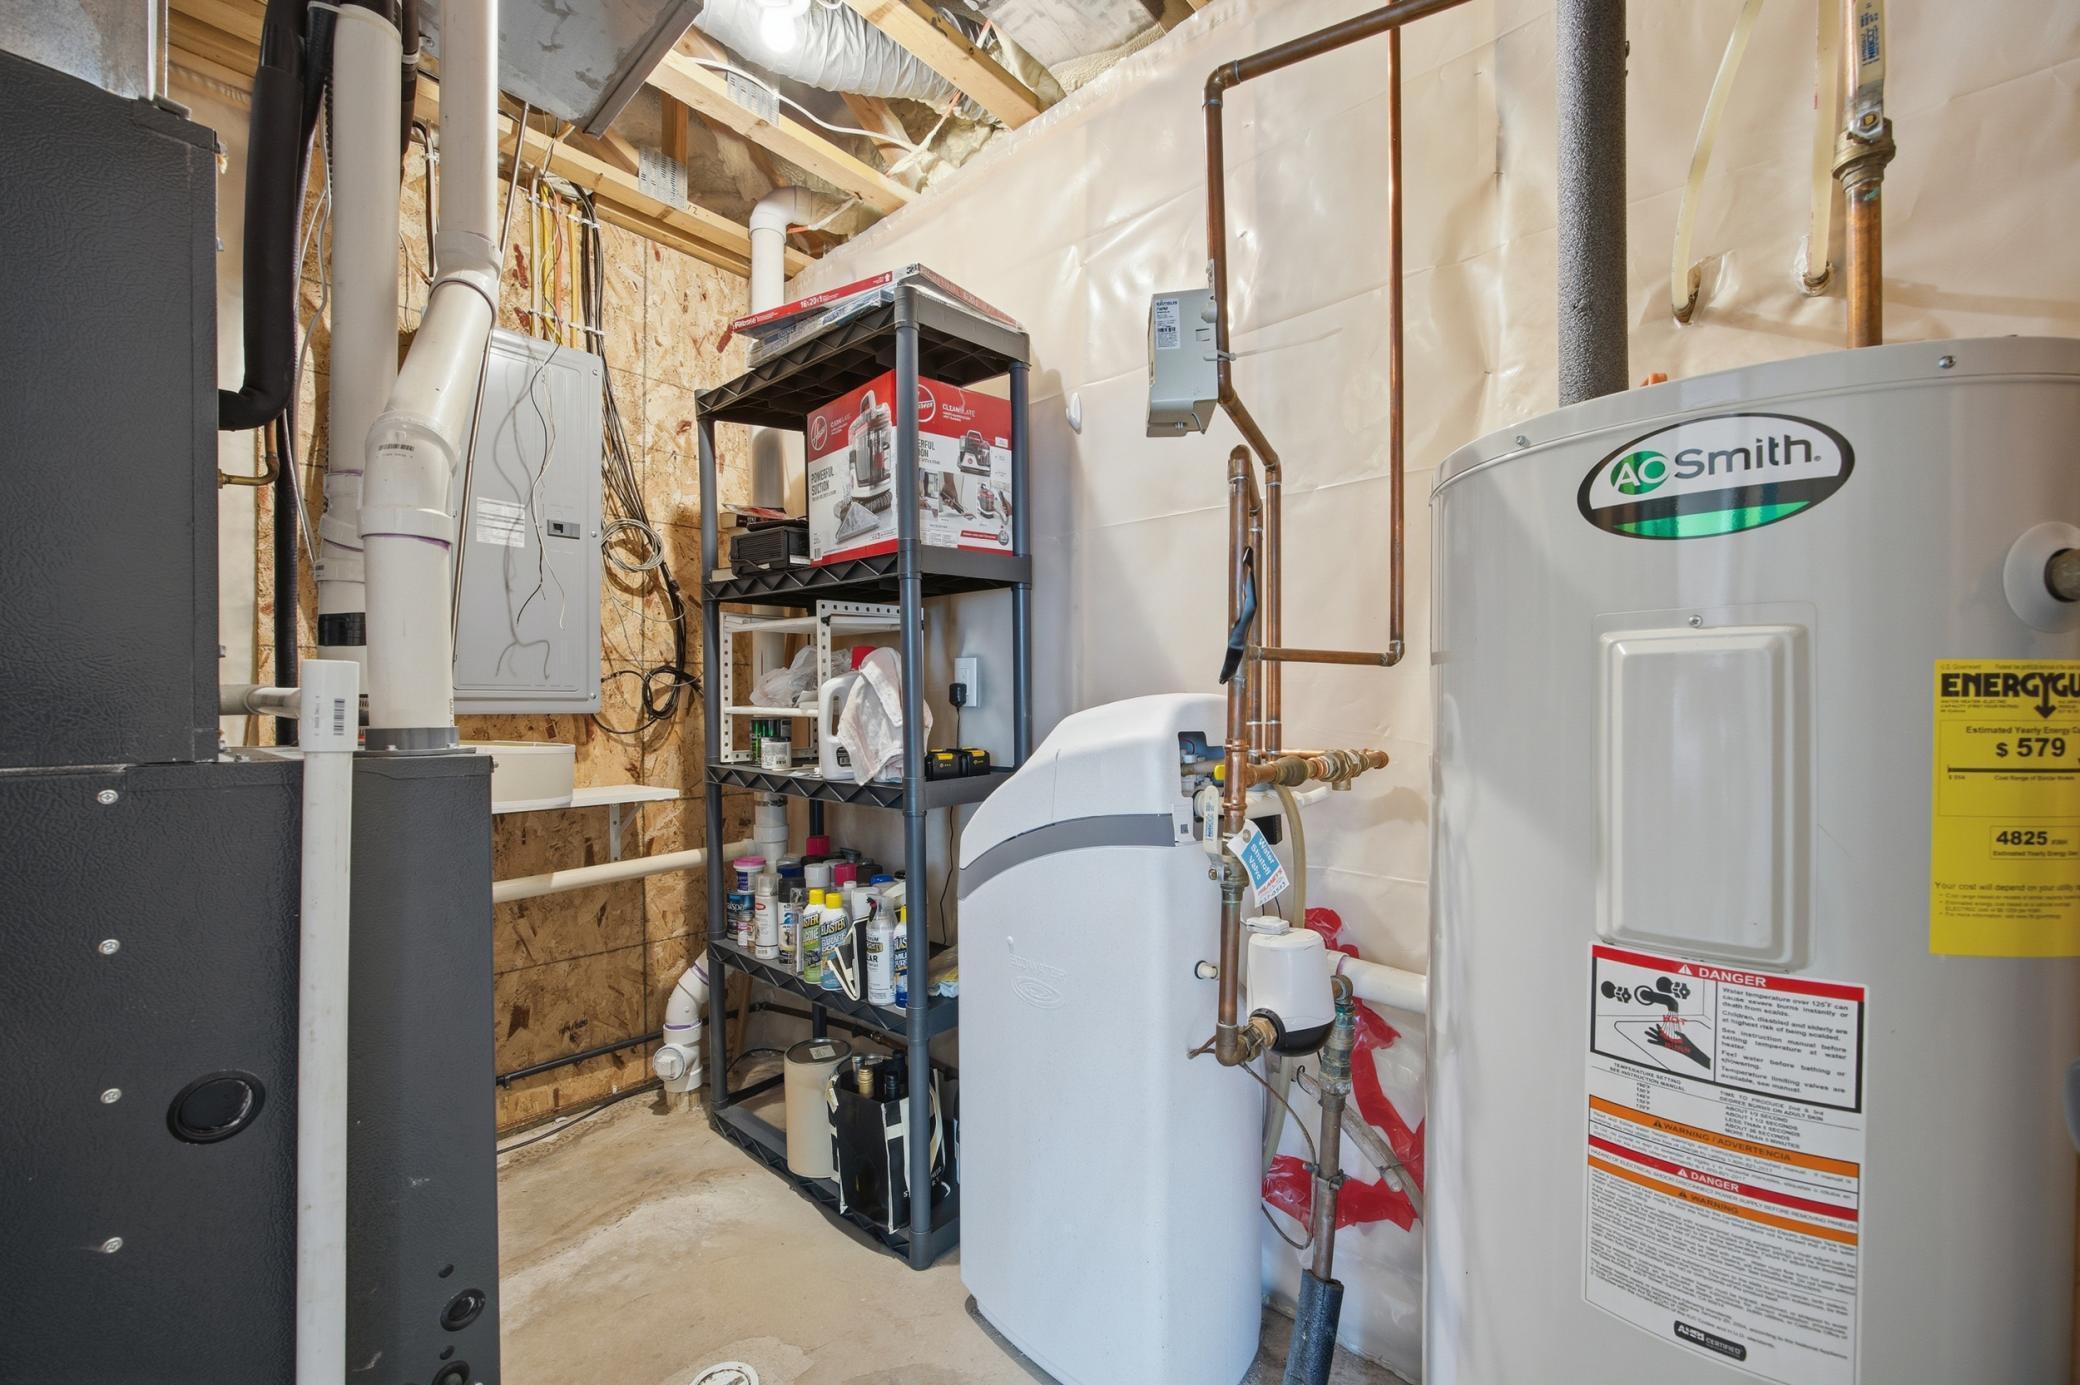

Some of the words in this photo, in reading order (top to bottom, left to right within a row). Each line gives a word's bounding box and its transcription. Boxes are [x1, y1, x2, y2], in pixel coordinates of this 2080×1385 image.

[810, 466, 834, 484] POWERFUL
[812, 480, 830, 496] SUCTION
[2015, 727, 2041, 735] Yearly
[2044, 727, 2070, 735] Energy
[1996, 742, 2008, 758] $
[2017, 737, 2066, 757] 579
[1996, 831, 2048, 846] 4825
[1699, 967, 1766, 988] DANGER
[1722, 987, 1743, 995] Water
[1745, 991, 1790, 1002] temperature
[1722, 1001, 1742, 1009] death
[1803, 1007, 1836, 1017] instantly
[1722, 1010, 1755, 1021] Children,
[1808, 1025, 1833, 1034] elderly
[1731, 1019, 1758, 1028] highest
[1785, 1028, 1806, 1037] being
[1809, 1032, 1840, 1041] scalded.
[1722, 1035, 1747, 1044] setting
[1755, 1041, 1802, 1053] temperature
[1740, 1031, 1782, 1043] instruction
[1788, 1040, 1816, 1048] manual
[1821, 1044, 1846, 1052] before
[1722, 1050, 1737, 1058] Feel
[1770, 1059, 1794, 1068] before
[1801, 1065, 1831, 1075] bathing
[1614, 1063, 1654, 1077] TEMPERATURE
[1656, 1074, 1681, 1084] SETTING
[1721, 1066, 1767, 1079] Temperature
[1772, 1076, 1800, 1086] limiting
[1804, 1083, 1828, 1091] valves
[1660, 1081, 1685, 1091] MANUAL
[1726, 1106, 1748, 1114] ABOUT
[1752, 1098, 1784, 1108] PRODUCE
[1726, 1112, 1748, 1120] ABOUT
[1664, 1122, 1709, 1140] WARNING
[1717, 1139, 1791, 1160] ADVERTENCIA
[1691, 1173, 1739, 1192] DANGER
[1691, 1194, 1738, 1214] WARNING
